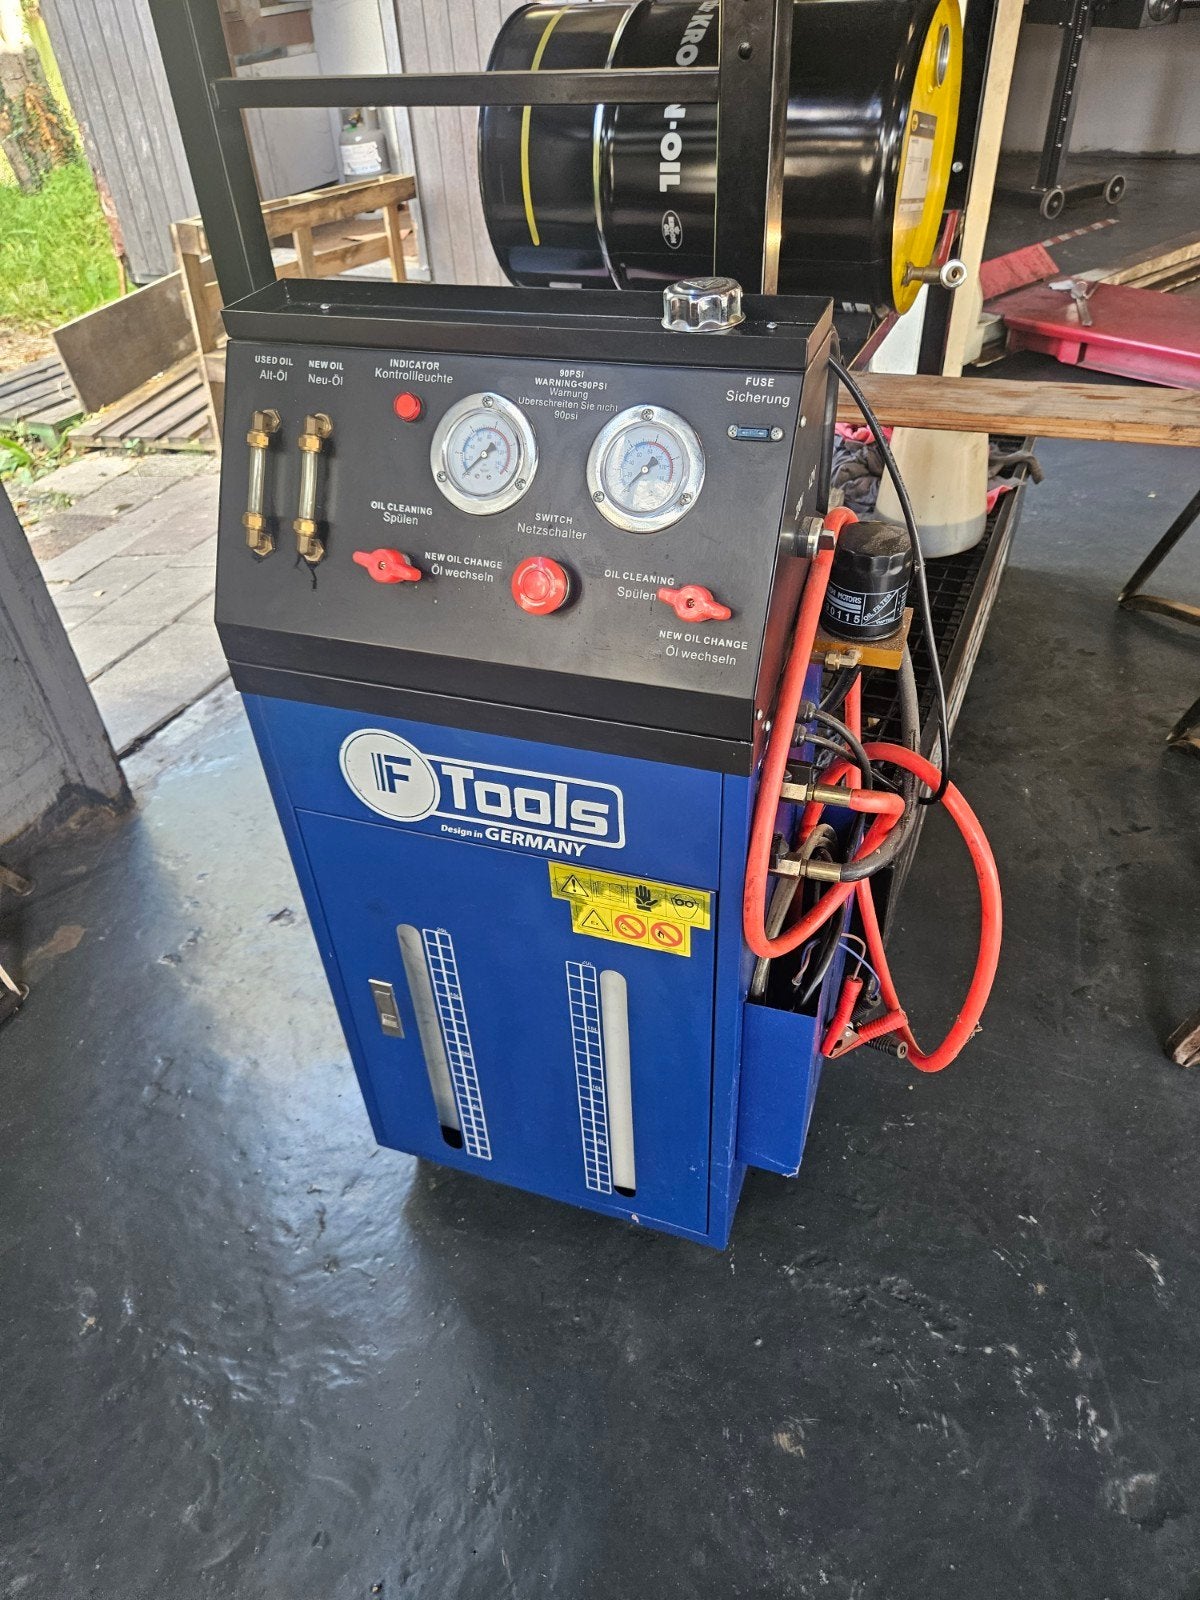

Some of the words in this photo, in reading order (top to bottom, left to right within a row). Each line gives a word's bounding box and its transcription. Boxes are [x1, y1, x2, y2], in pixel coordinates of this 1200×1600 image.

[254, 355, 278, 365] USED
[279, 357, 294, 366] OIL
[308, 360, 329, 369] NEW
[329, 362, 345, 371] OIL
[389, 358, 440, 370] INDICATOR
[259, 369, 288, 382] Alt-Öl
[307, 373, 343, 386] Neu-Öl
[374, 367, 454, 384] Kontrollleuchte
[559, 369, 585, 379] 90PSI
[745, 376, 775, 388] FUSE
[549, 387, 589, 401] Warnung
[725, 389, 791, 408] Sicherung
[580, 401, 595, 411] Sie
[553, 410, 579, 421] 90psi
[370, 500, 385, 510] OIL
[387, 502, 433, 516] CLEANING
[382, 511, 419, 526] Spülen
[534, 512, 573, 525] SWITCH
[517, 522, 587, 540] Netzschalter
[424, 551, 446, 562] NEW
[446, 554, 462, 564] OIL
[463, 556, 503, 570] CHANGE
[431, 563, 443, 576] Öl
[444, 568, 494, 583] wechseln
[604, 569, 621, 579] OIL
[622, 571, 675, 586] CLEANING
[617, 586, 657, 601] Spülen
[659, 630, 682, 641] NEW
[683, 633, 702, 644] OIL
[703, 636, 749, 651] CHANGE
[665, 644, 679, 657] Öl
[680, 650, 737, 666] wechseln
[440, 764, 610, 836] Tools
[440, 824, 472, 837] Design
[473, 829, 483, 839] in
[484, 826, 587, 857] GERMANY
